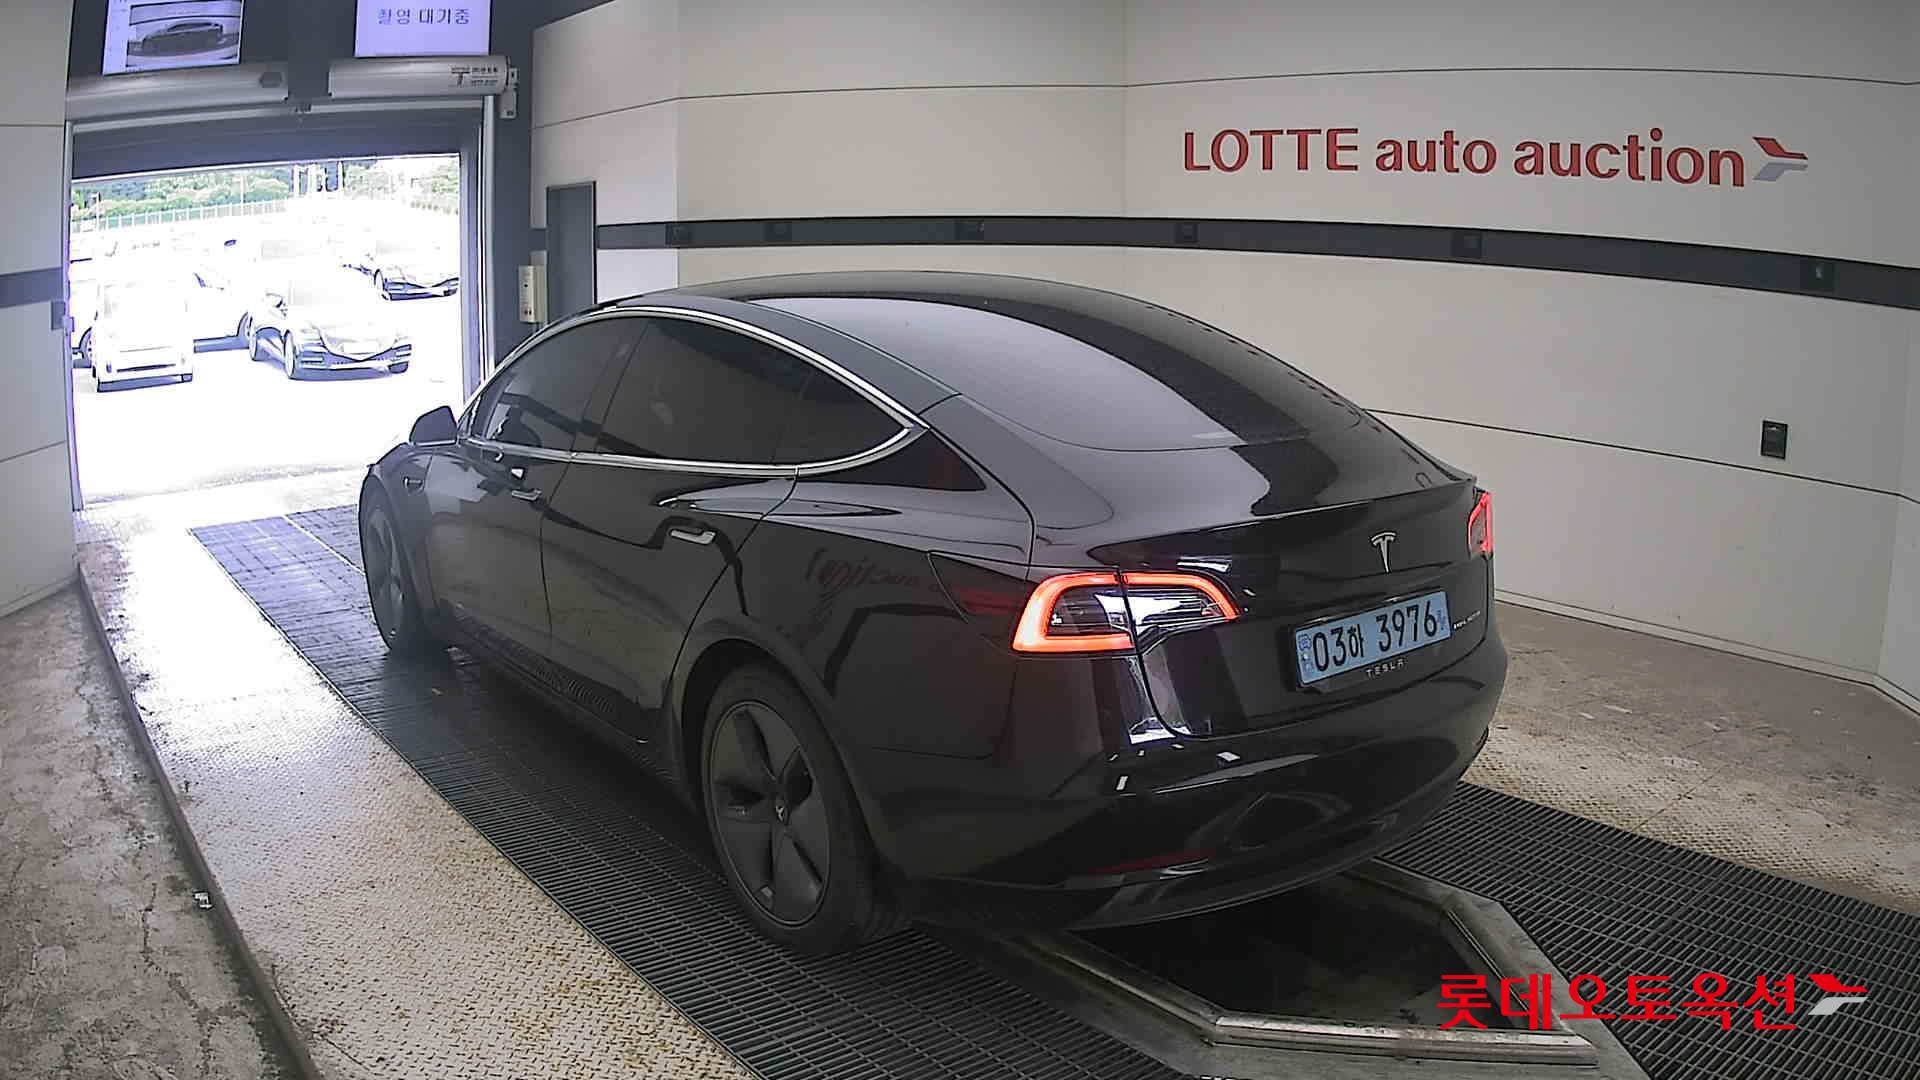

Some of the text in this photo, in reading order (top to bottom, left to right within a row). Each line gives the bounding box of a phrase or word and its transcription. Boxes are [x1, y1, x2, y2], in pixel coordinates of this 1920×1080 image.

[419, 8, 469, 25] 대기중
[1184, 128, 1745, 187] LOTTE auto auction
[1312, 623, 1365, 672] 03하
[1375, 600, 1438, 652] 3976
[1366, 658, 1408, 679] TESLA
